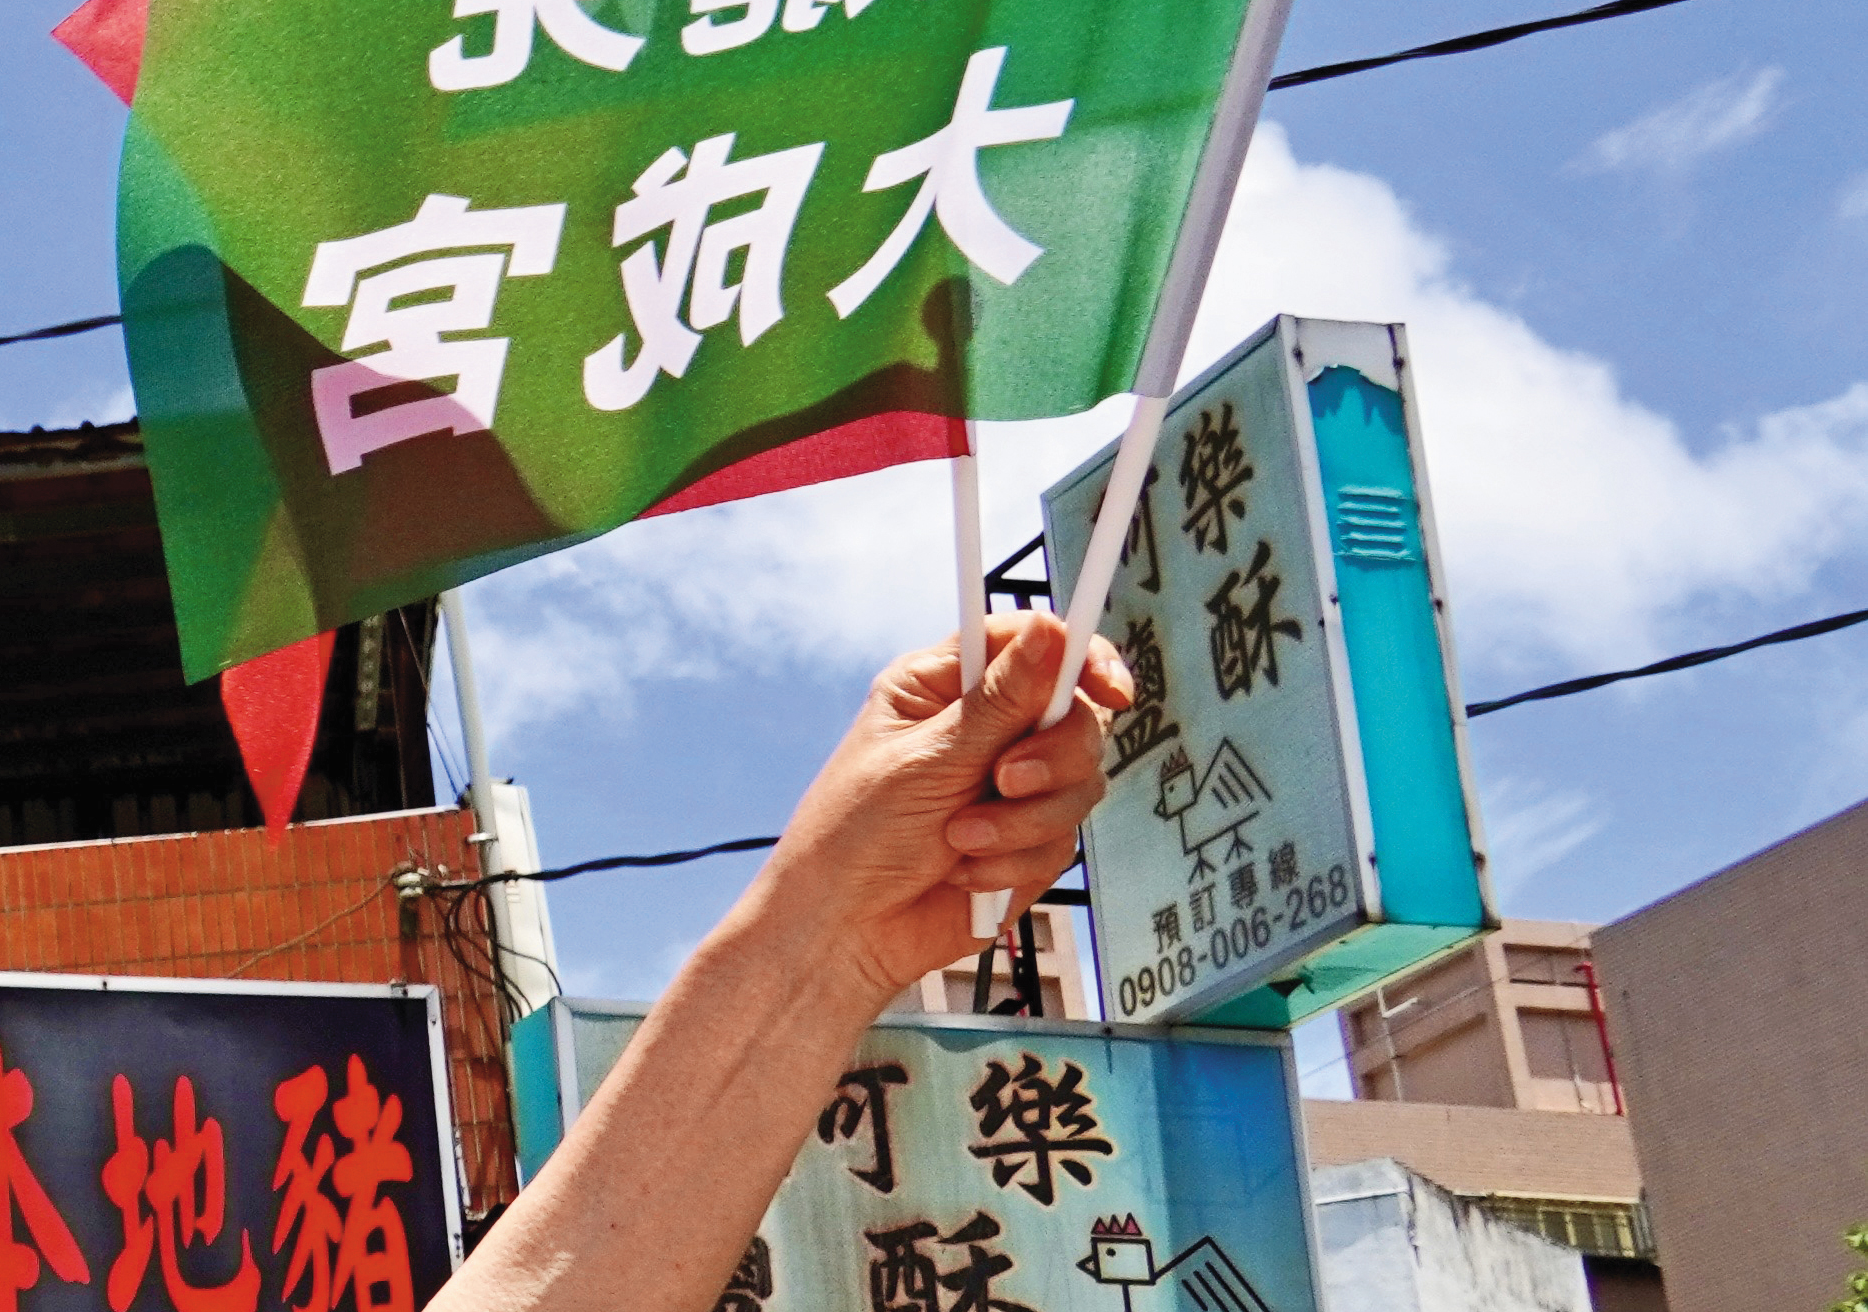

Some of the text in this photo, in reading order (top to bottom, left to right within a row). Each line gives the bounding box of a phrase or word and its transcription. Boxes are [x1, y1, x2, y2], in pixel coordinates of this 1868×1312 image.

[1119, 863, 1349, 1018] 0908-006-268
[1151, 840, 1300, 954] 預訂專線
